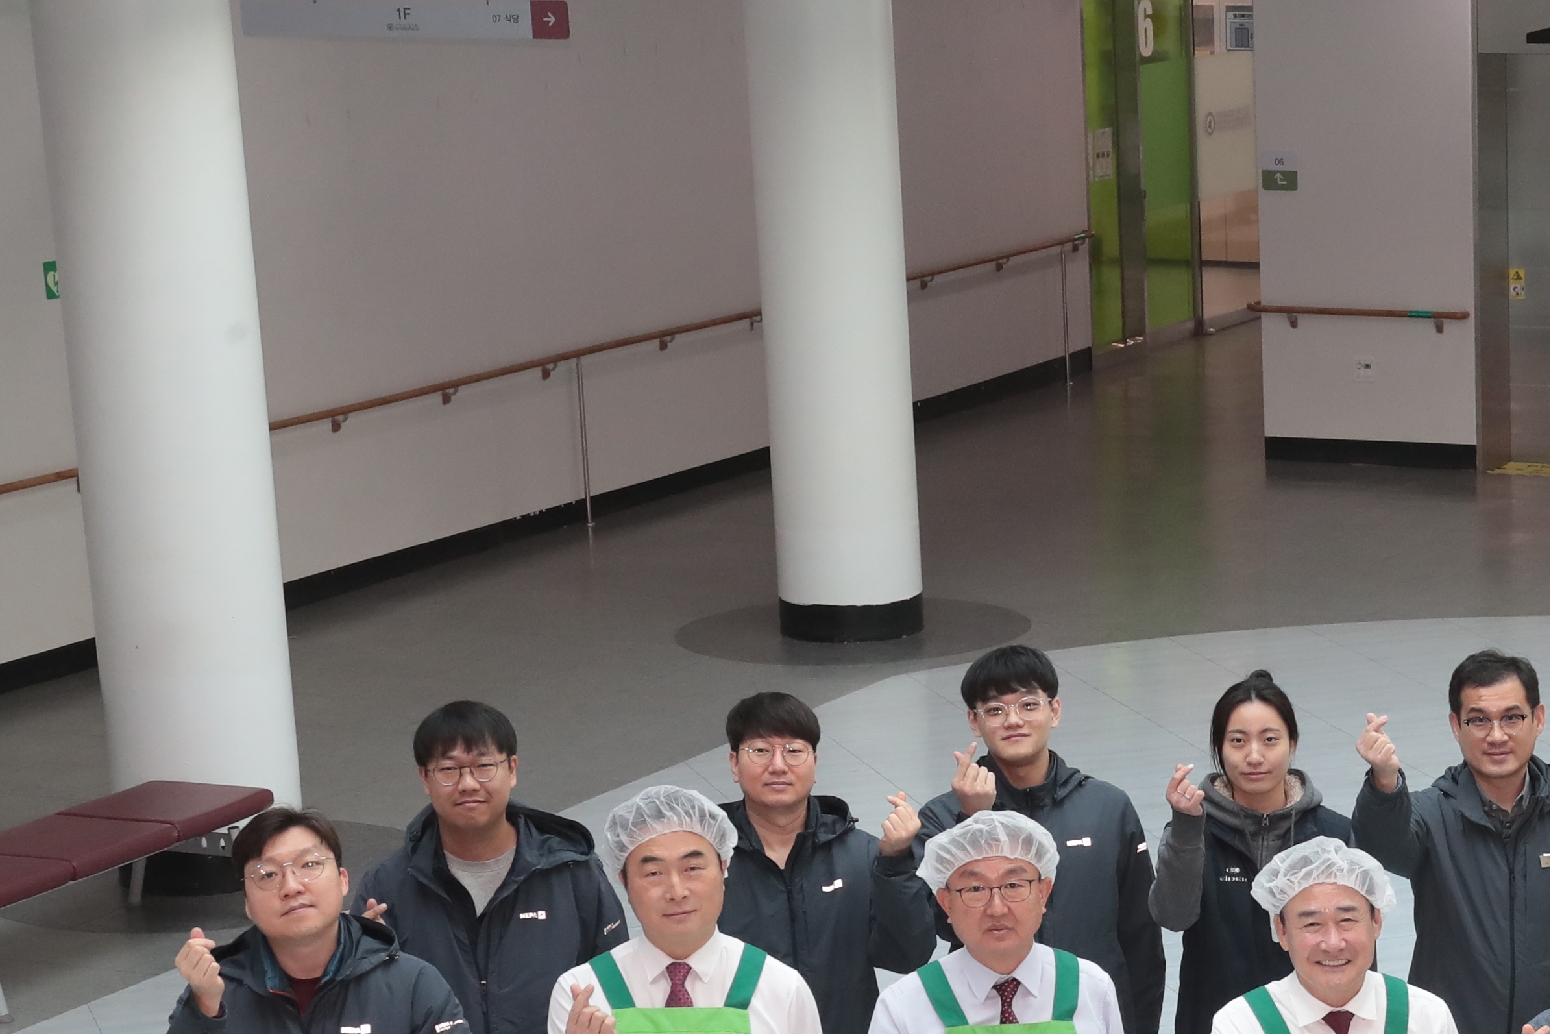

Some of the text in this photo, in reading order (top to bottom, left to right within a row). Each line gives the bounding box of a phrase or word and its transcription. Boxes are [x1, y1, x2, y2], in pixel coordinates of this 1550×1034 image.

[396, 7, 412, 20] 1F
[491, 13, 520, 24] 07 식당
[1274, 158, 1285, 166] 06
